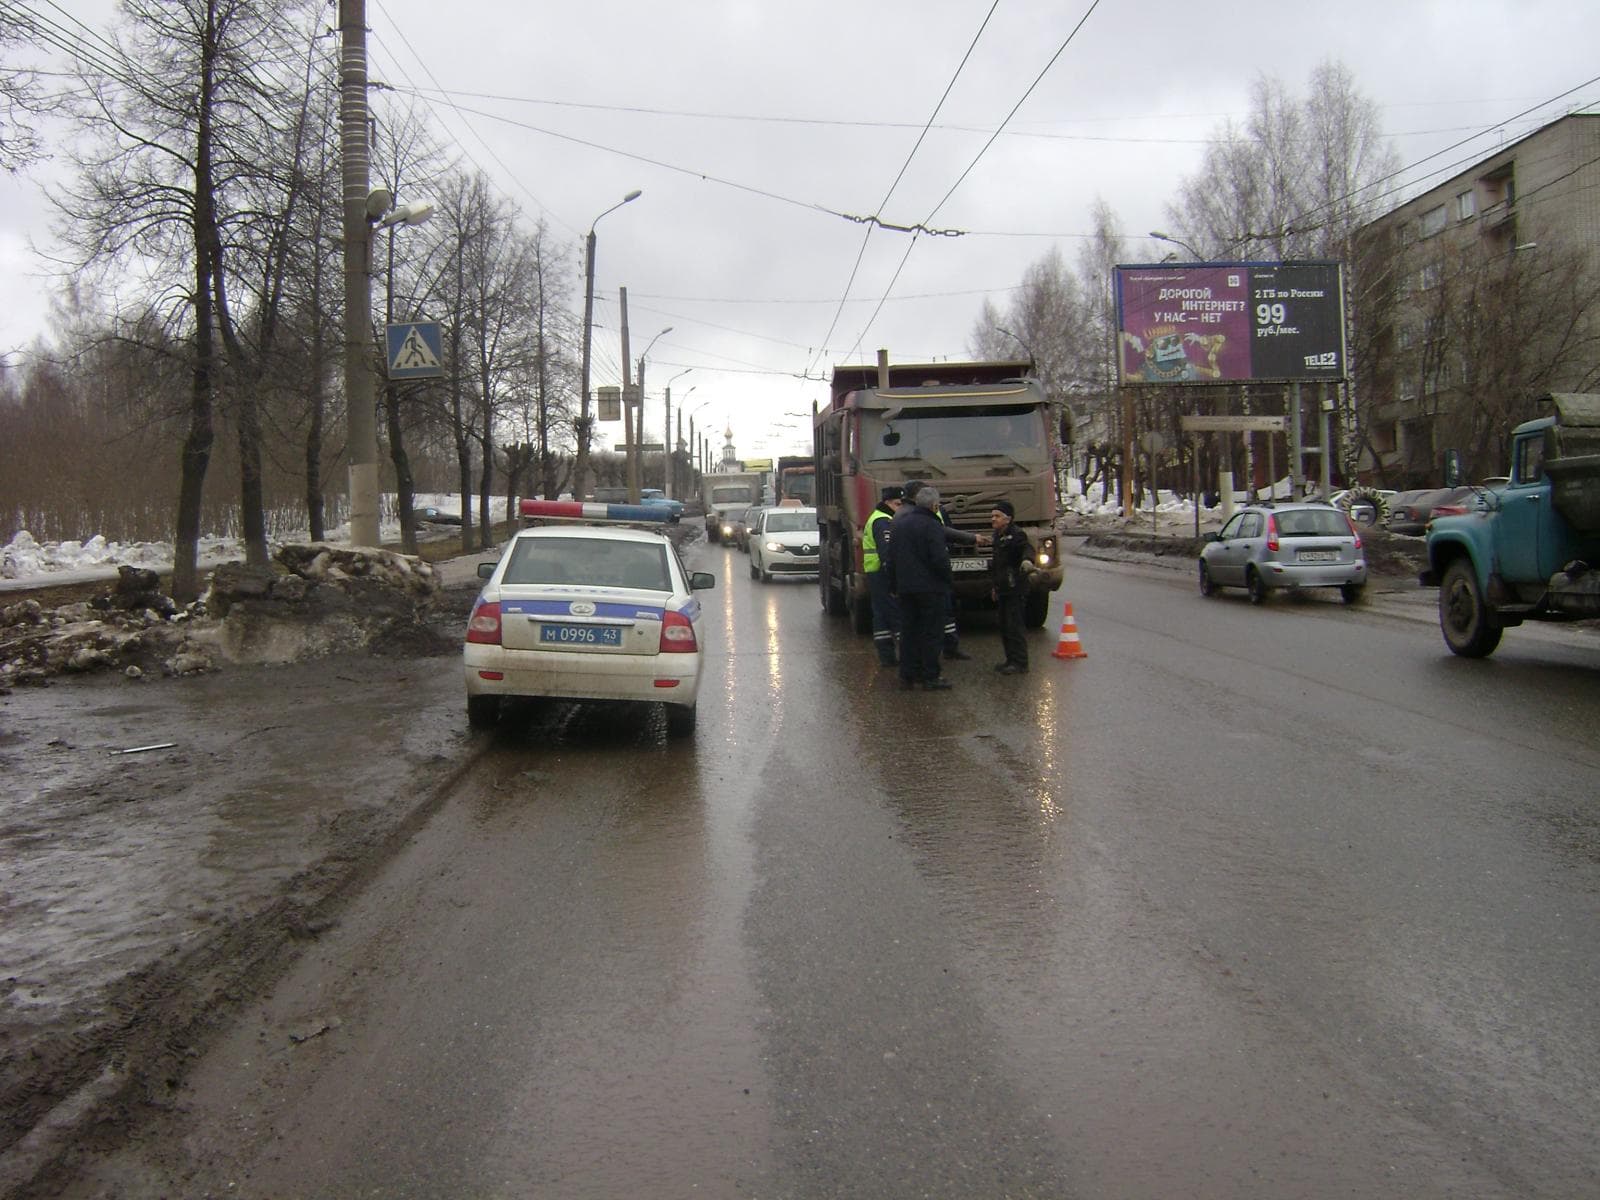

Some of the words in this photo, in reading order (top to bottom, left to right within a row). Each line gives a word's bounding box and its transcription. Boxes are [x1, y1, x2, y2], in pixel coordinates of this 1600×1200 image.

[1159, 288, 1211, 300] ДОРОГОЙ
[1255, 289, 1261, 298] 2
[1263, 289, 1275, 298] ГБ
[1290, 289, 1324, 298] России
[1154, 312, 1162, 322] У
[1164, 312, 1187, 323] НАС
[1201, 312, 1222, 323] НЕТ
[1256, 303, 1286, 325] 99
[1257, 325, 1300, 337] руб./мес.
[1303, 352, 1336, 366] TELE2
[560, 628, 595, 641] 0996
[603, 629, 617, 640] 43
